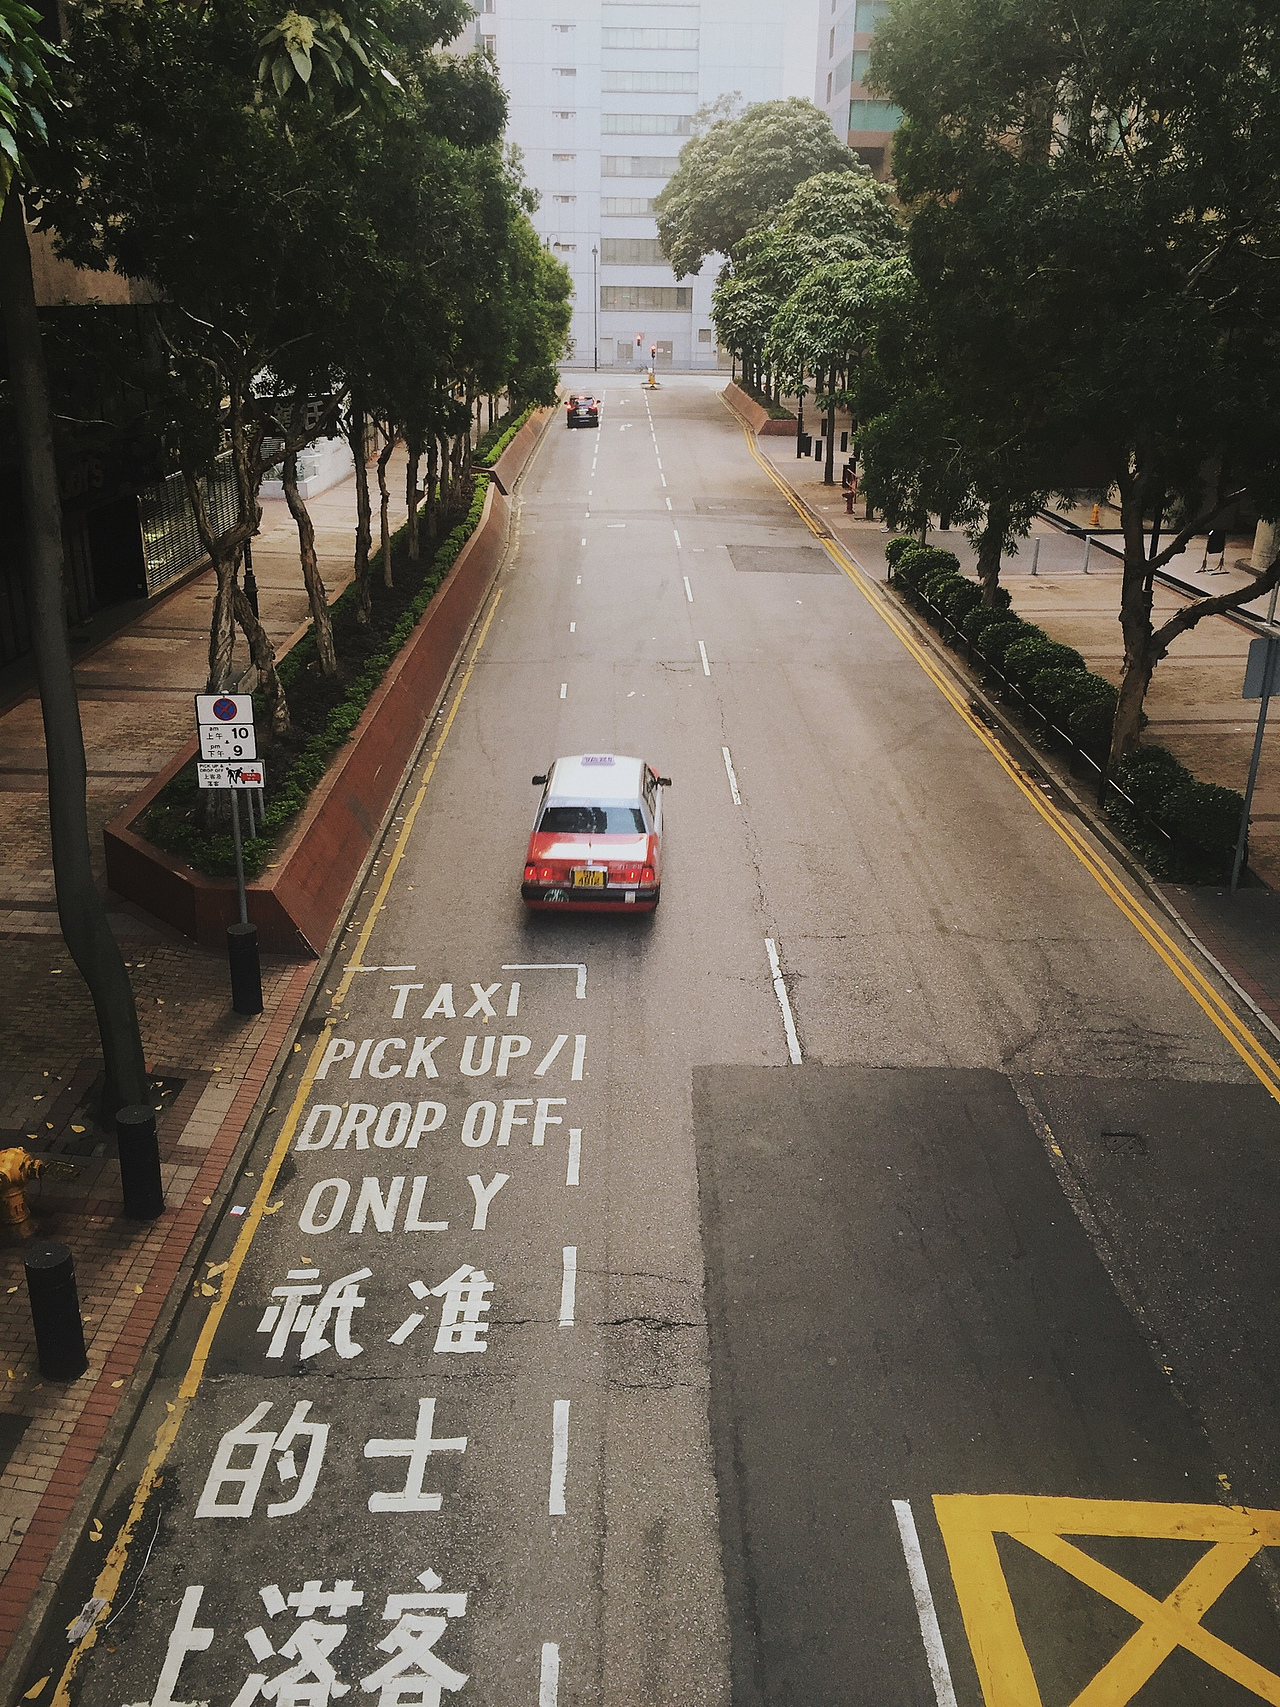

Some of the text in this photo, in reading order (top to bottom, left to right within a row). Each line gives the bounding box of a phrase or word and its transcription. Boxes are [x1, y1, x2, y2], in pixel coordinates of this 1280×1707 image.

[206, 732, 223, 740] 上午
[231, 727, 249, 739] 10
[233, 745, 243, 756] 9
[390, 982, 521, 1019] TAXI
[315, 1036, 448, 1080] PICK
[295, 1098, 567, 1151] DROP OFF
[298, 1172, 510, 1234] ONLY
[194, 1397, 469, 1519] 的士
